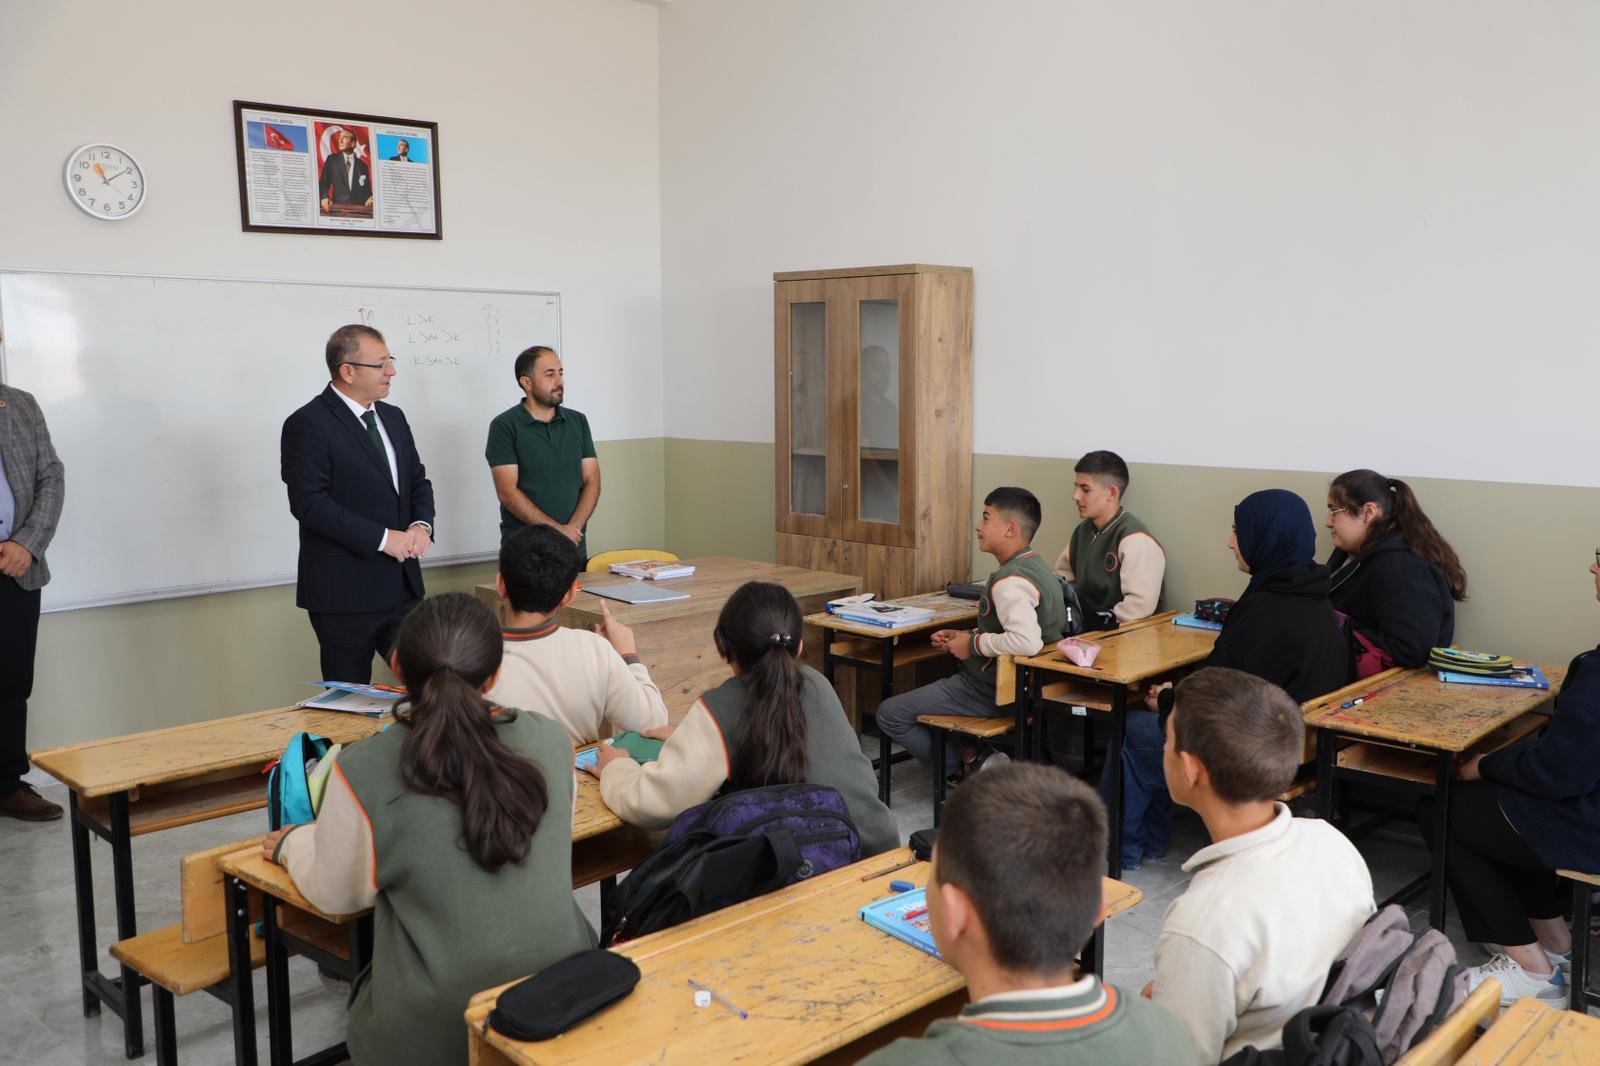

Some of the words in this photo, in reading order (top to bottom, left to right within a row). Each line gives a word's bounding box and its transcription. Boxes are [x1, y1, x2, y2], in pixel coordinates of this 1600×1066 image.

[89, 152, 95, 160] 11
[101, 151, 112, 160] 12
[79, 160, 90, 169] 10
[126, 166, 134, 175] 2
[73, 174, 82, 182] 9
[131, 181, 138, 189] 3
[78, 188, 87, 196] 8
[127, 193, 134, 201] 4
[88, 198, 96, 206] 7
[118, 202, 126, 210] 5
[103, 203, 111, 211] 6
